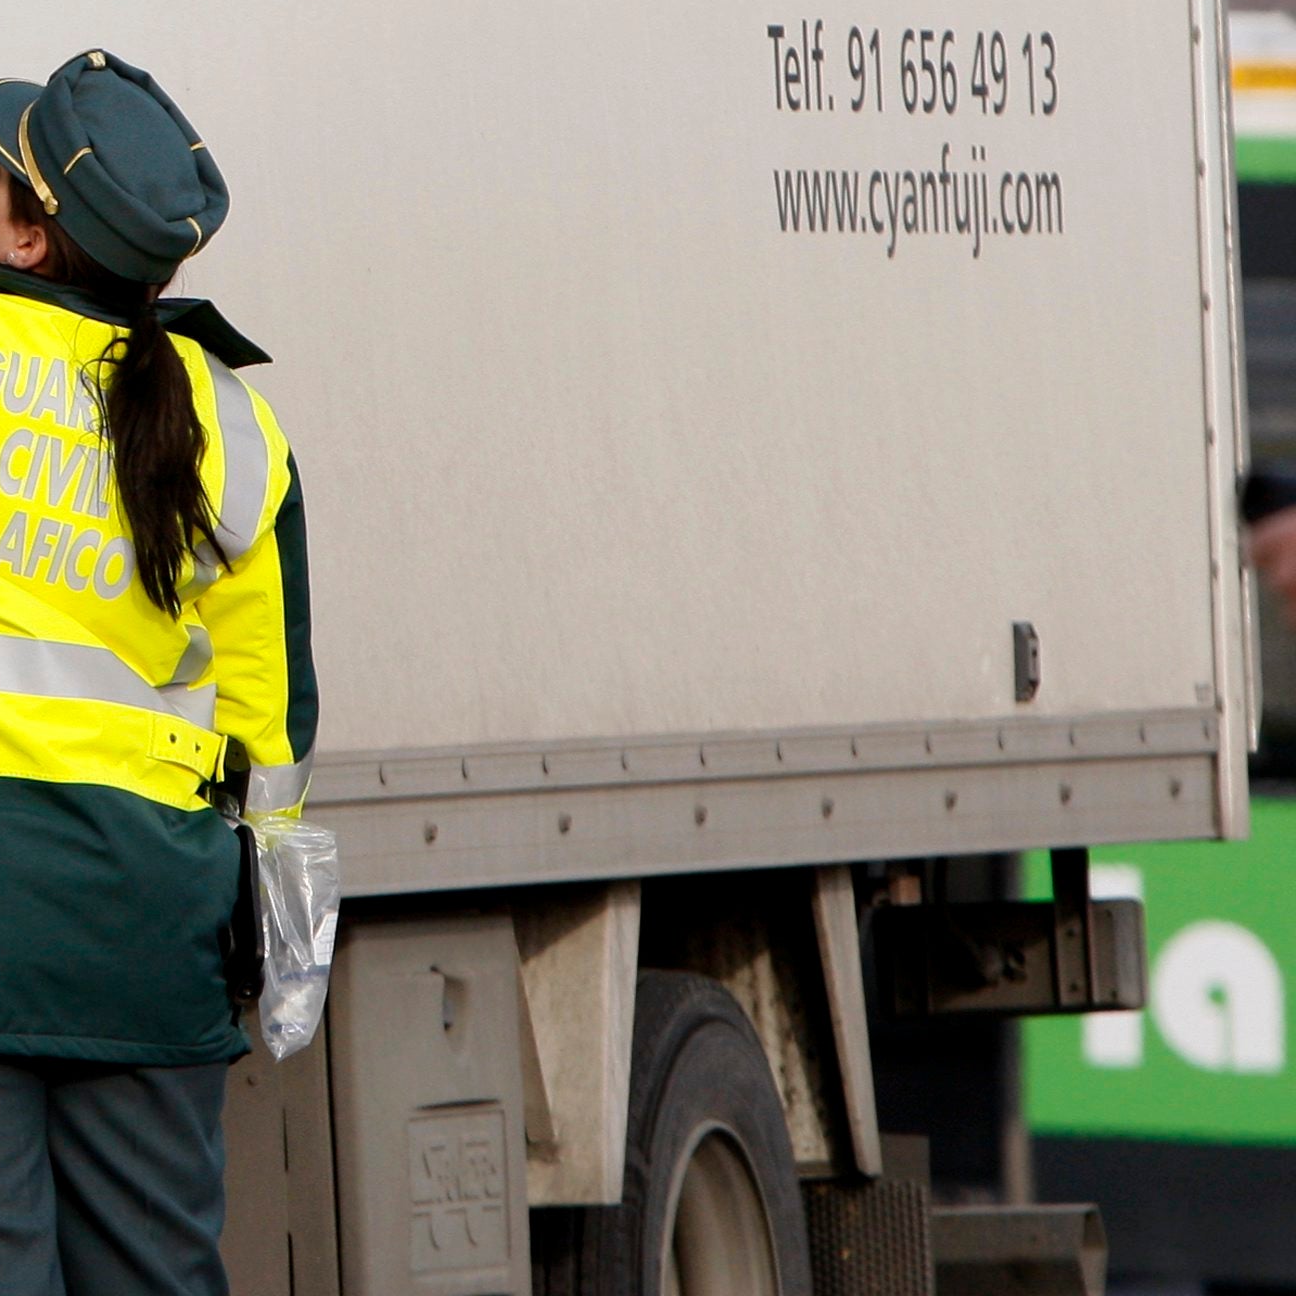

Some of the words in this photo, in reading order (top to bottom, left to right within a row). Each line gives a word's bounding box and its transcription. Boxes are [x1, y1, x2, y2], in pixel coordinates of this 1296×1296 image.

[768, 19, 833, 112] Telf.
[847, 27, 883, 111] 91
[900, 29, 957, 115] 656
[971, 31, 1007, 115] 49
[1023, 31, 1057, 116] 13
[774, 144, 1064, 258] www.cyanfuji.com
